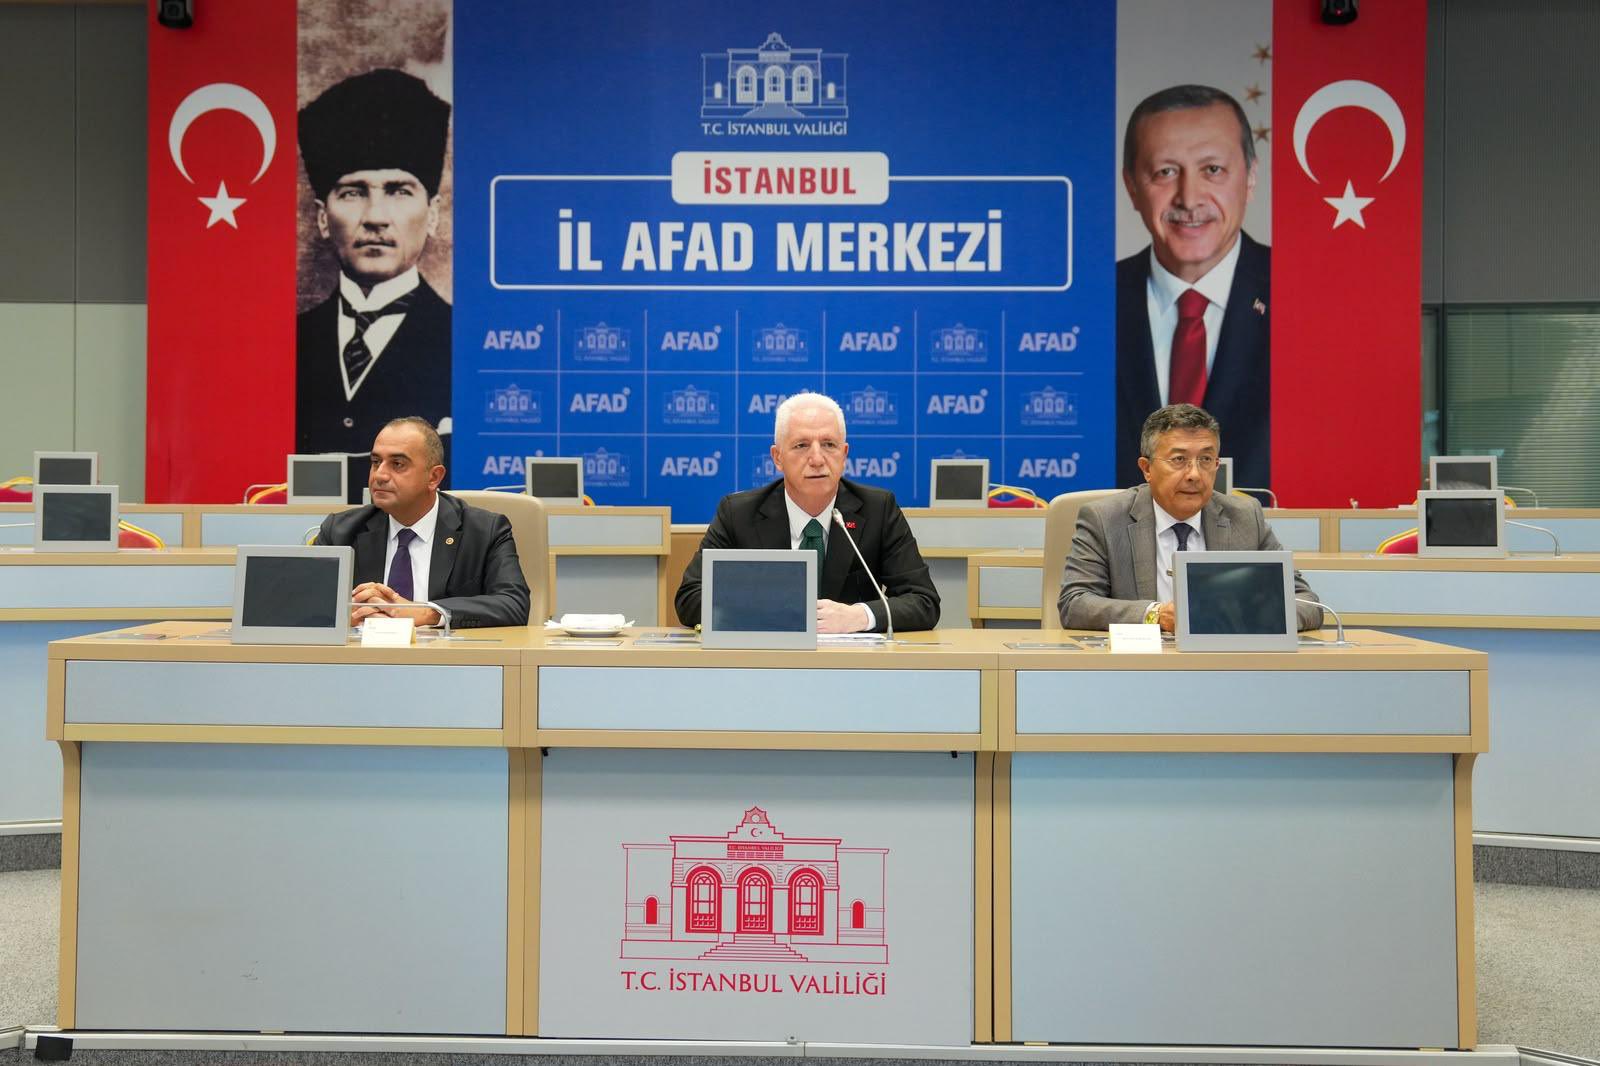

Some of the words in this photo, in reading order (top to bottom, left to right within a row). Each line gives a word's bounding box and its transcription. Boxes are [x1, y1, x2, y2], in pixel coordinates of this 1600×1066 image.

[701, 123, 724, 136] T.C.
[728, 120, 791, 136] İSTANBUL
[793, 120, 848, 136] VALİLİĞİ
[703, 160, 856, 195] İSTANBUL
[558, 208, 603, 272] İL
[621, 221, 754, 272] AFAD
[776, 209, 1002, 272] MERKEZİ
[483, 330, 541, 350] AFAD
[661, 331, 719, 351] AFAD
[840, 332, 898, 352] AFAD
[1018, 332, 1077, 352] AFAD
[570, 393, 628, 413] AFAD
[748, 394, 788, 414] AF
[927, 395, 986, 415] AFAD
[483, 455, 526, 475] AFA
[661, 457, 719, 477] AFAD
[1018, 458, 1077, 478] AFAD
[621, 970, 661, 991] T.C.
[669, 968, 783, 993] İSTANBUL
[789, 971, 887, 996] VALİLİĞİ
